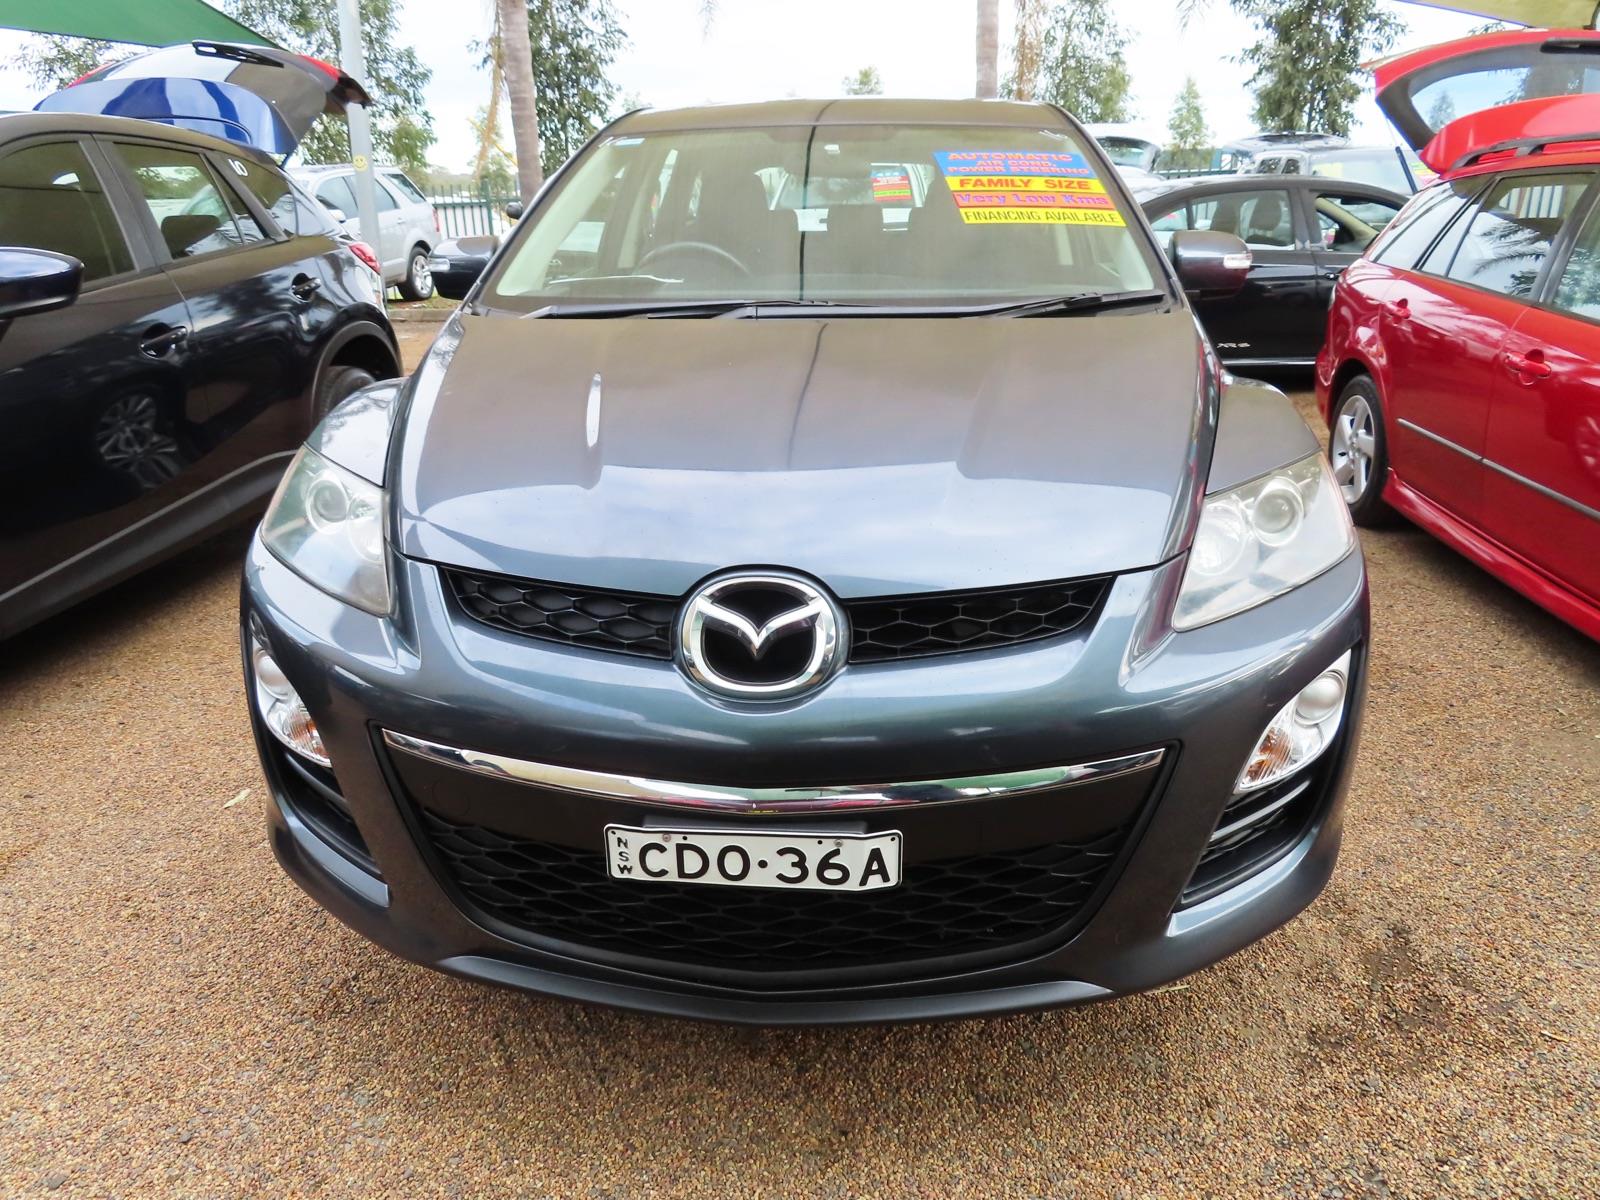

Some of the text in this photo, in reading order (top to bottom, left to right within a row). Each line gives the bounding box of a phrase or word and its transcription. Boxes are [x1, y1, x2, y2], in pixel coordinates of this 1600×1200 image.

[948, 152, 1073, 162] AUTOMATIC
[959, 178, 1091, 190] FAMILY SIZE
[957, 193, 1110, 206] Very Low Kms
[964, 211, 1121, 223] FINANCING AVAILABLE
